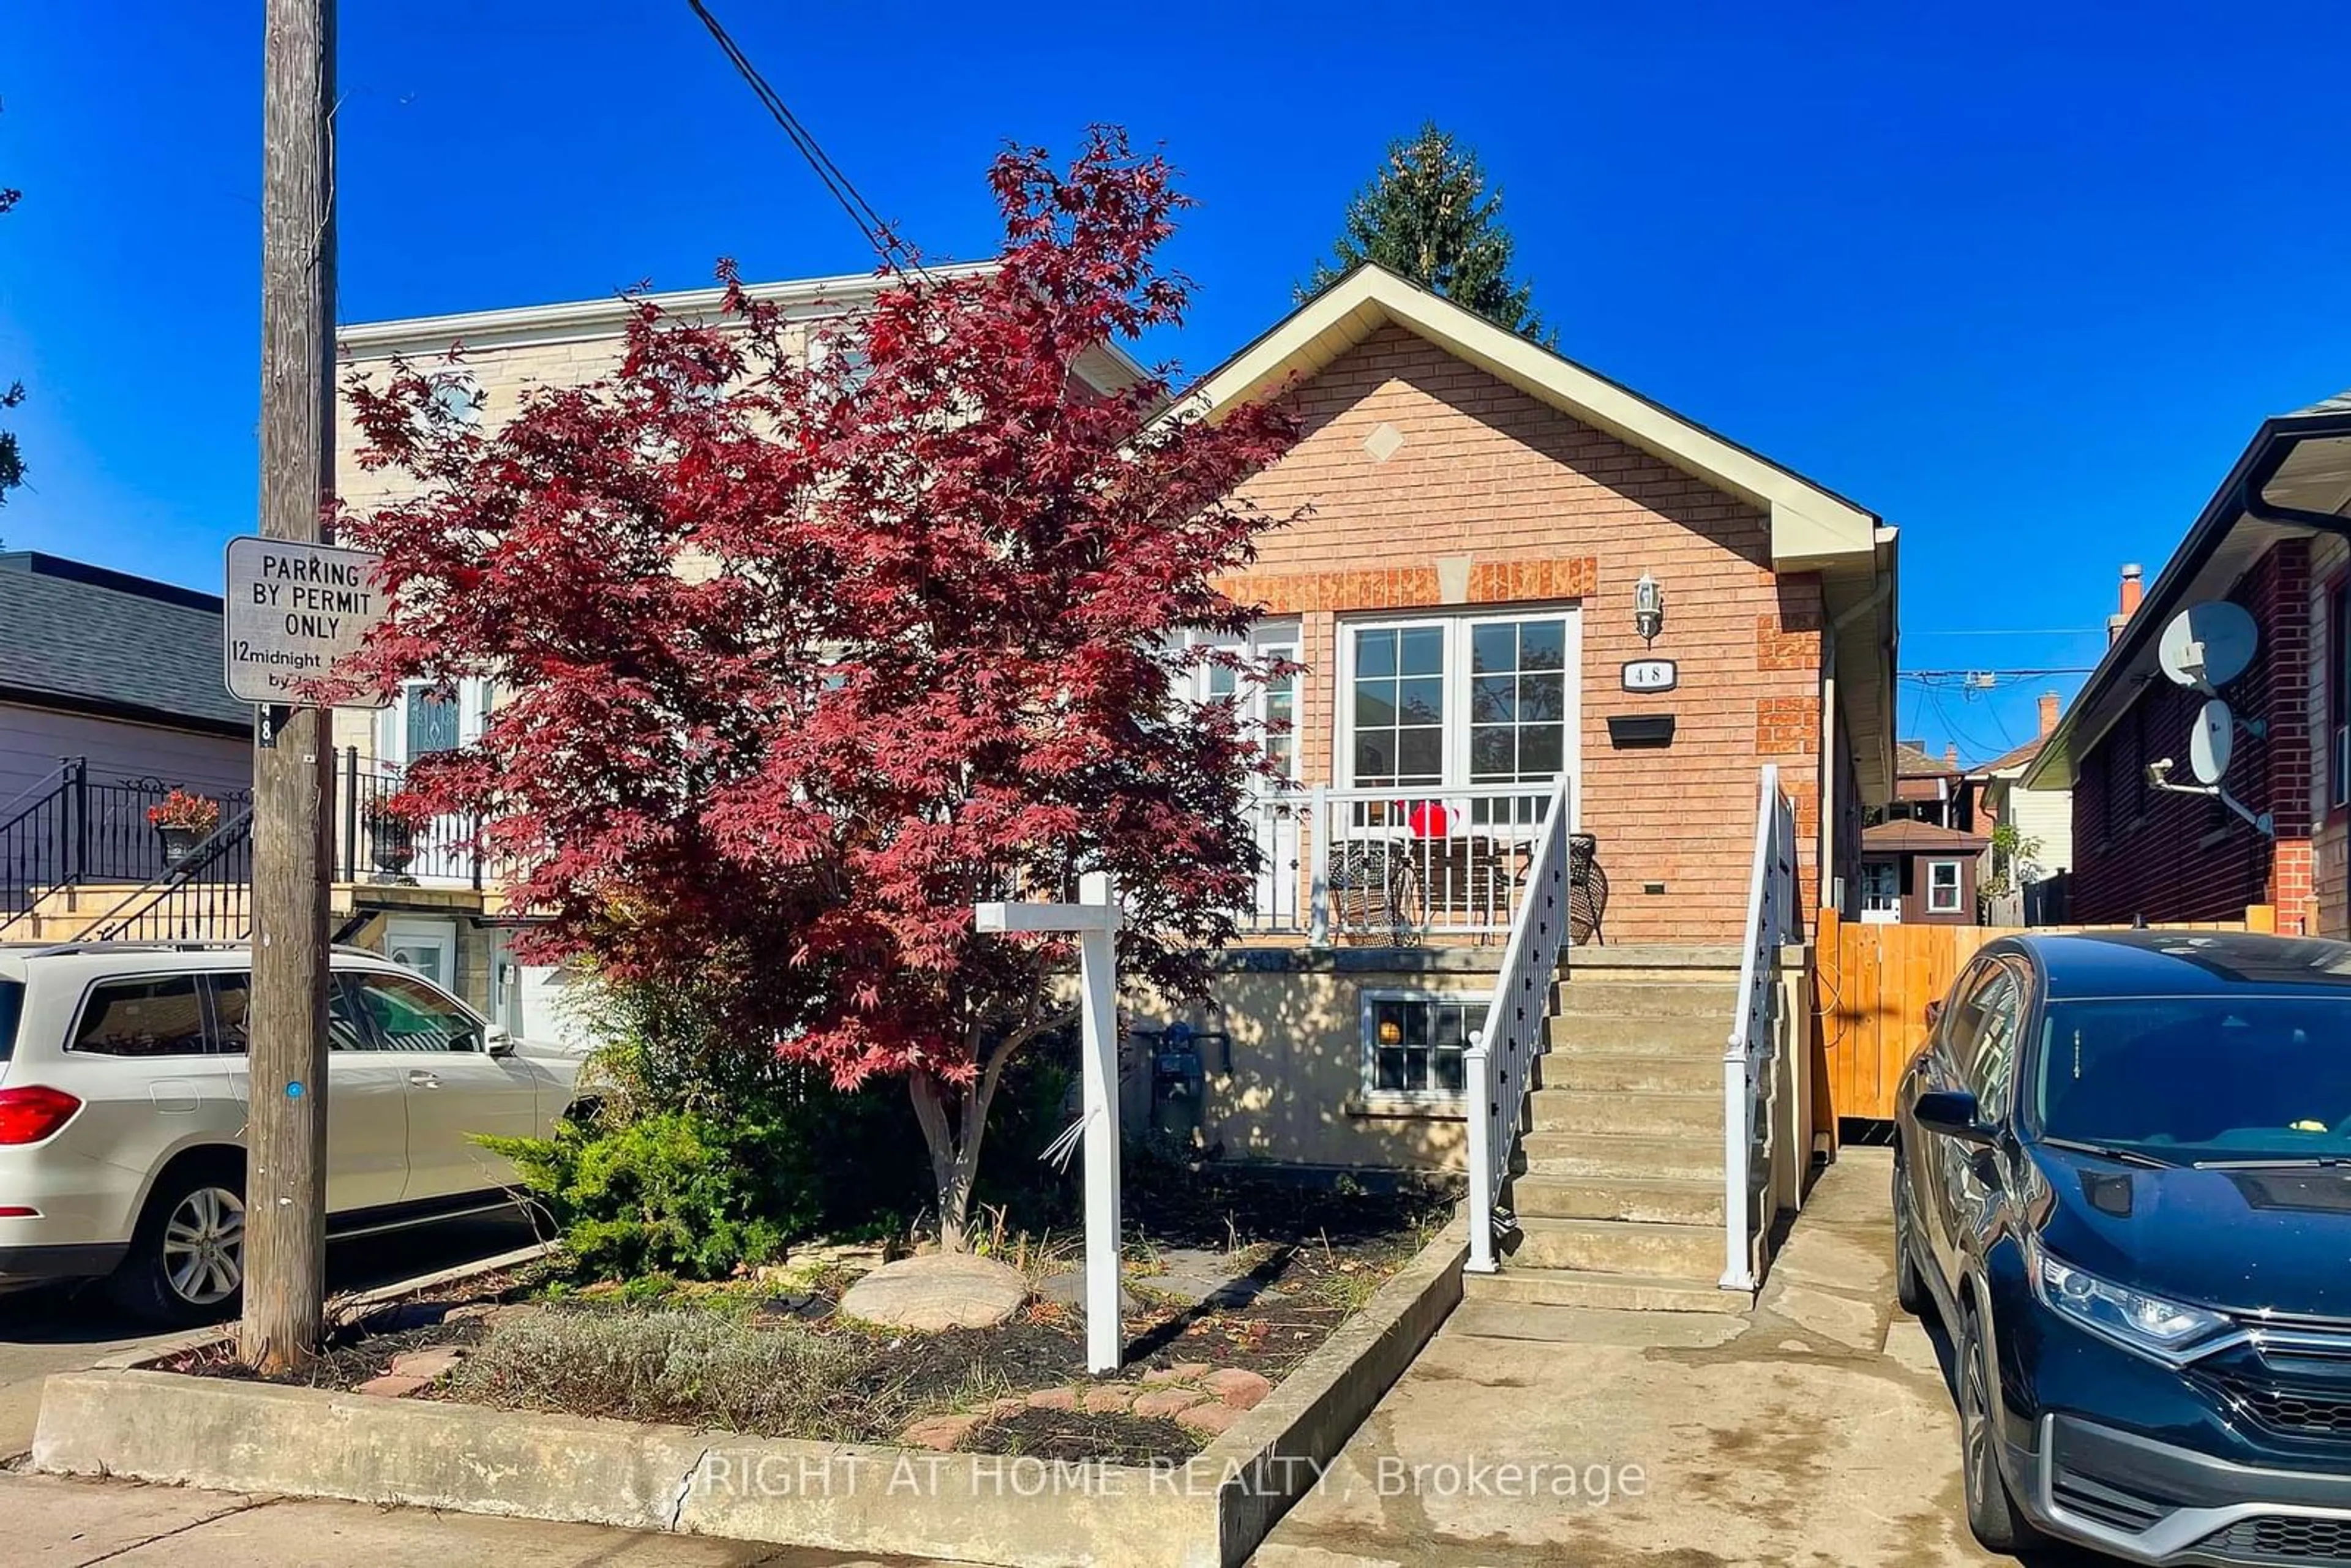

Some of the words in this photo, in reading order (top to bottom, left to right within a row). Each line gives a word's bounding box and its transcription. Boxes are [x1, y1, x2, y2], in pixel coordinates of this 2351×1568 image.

[263, 555, 359, 587] PARKING
[253, 583, 280, 606] BY
[293, 587, 371, 615] PERMIT
[285, 613, 339, 639] ONLY
[232, 640, 321, 669] 12midnight
[268, 673, 289, 690] by
[1635, 666, 1660, 683] 48
